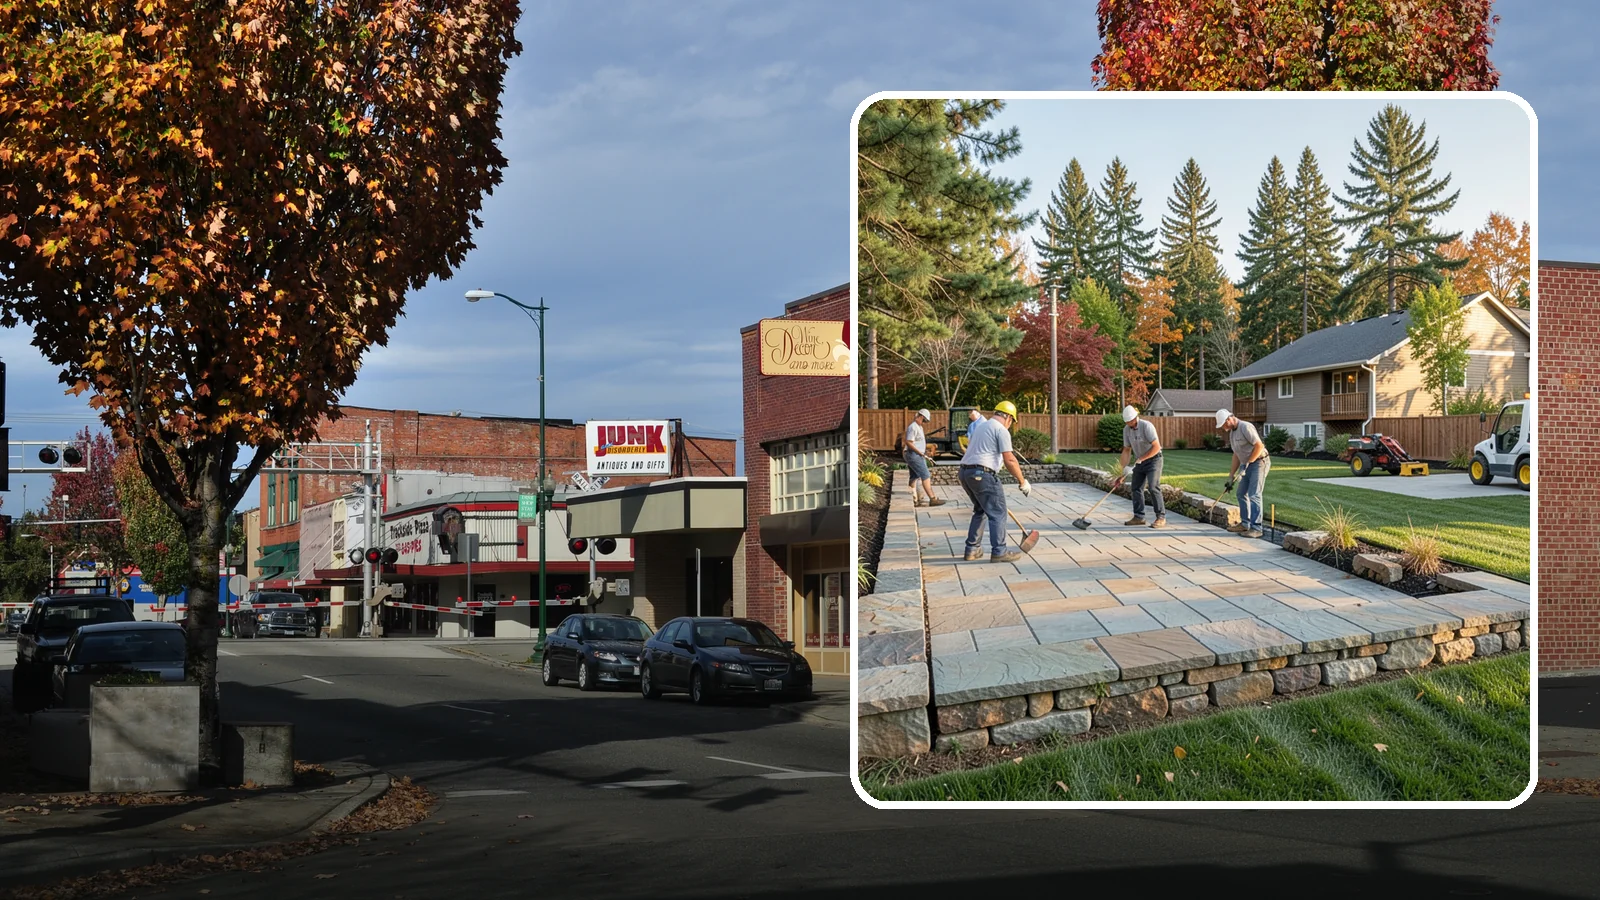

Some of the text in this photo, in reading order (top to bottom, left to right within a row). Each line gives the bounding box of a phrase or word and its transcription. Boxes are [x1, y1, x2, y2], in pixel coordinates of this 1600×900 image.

[596, 425, 664, 457] JUNK
[607, 446, 646, 454] DISORDERLY
[597, 461, 665, 470] ANTIQUES AND GIFTS
[390, 519, 429, 540] Trackside Pizza
